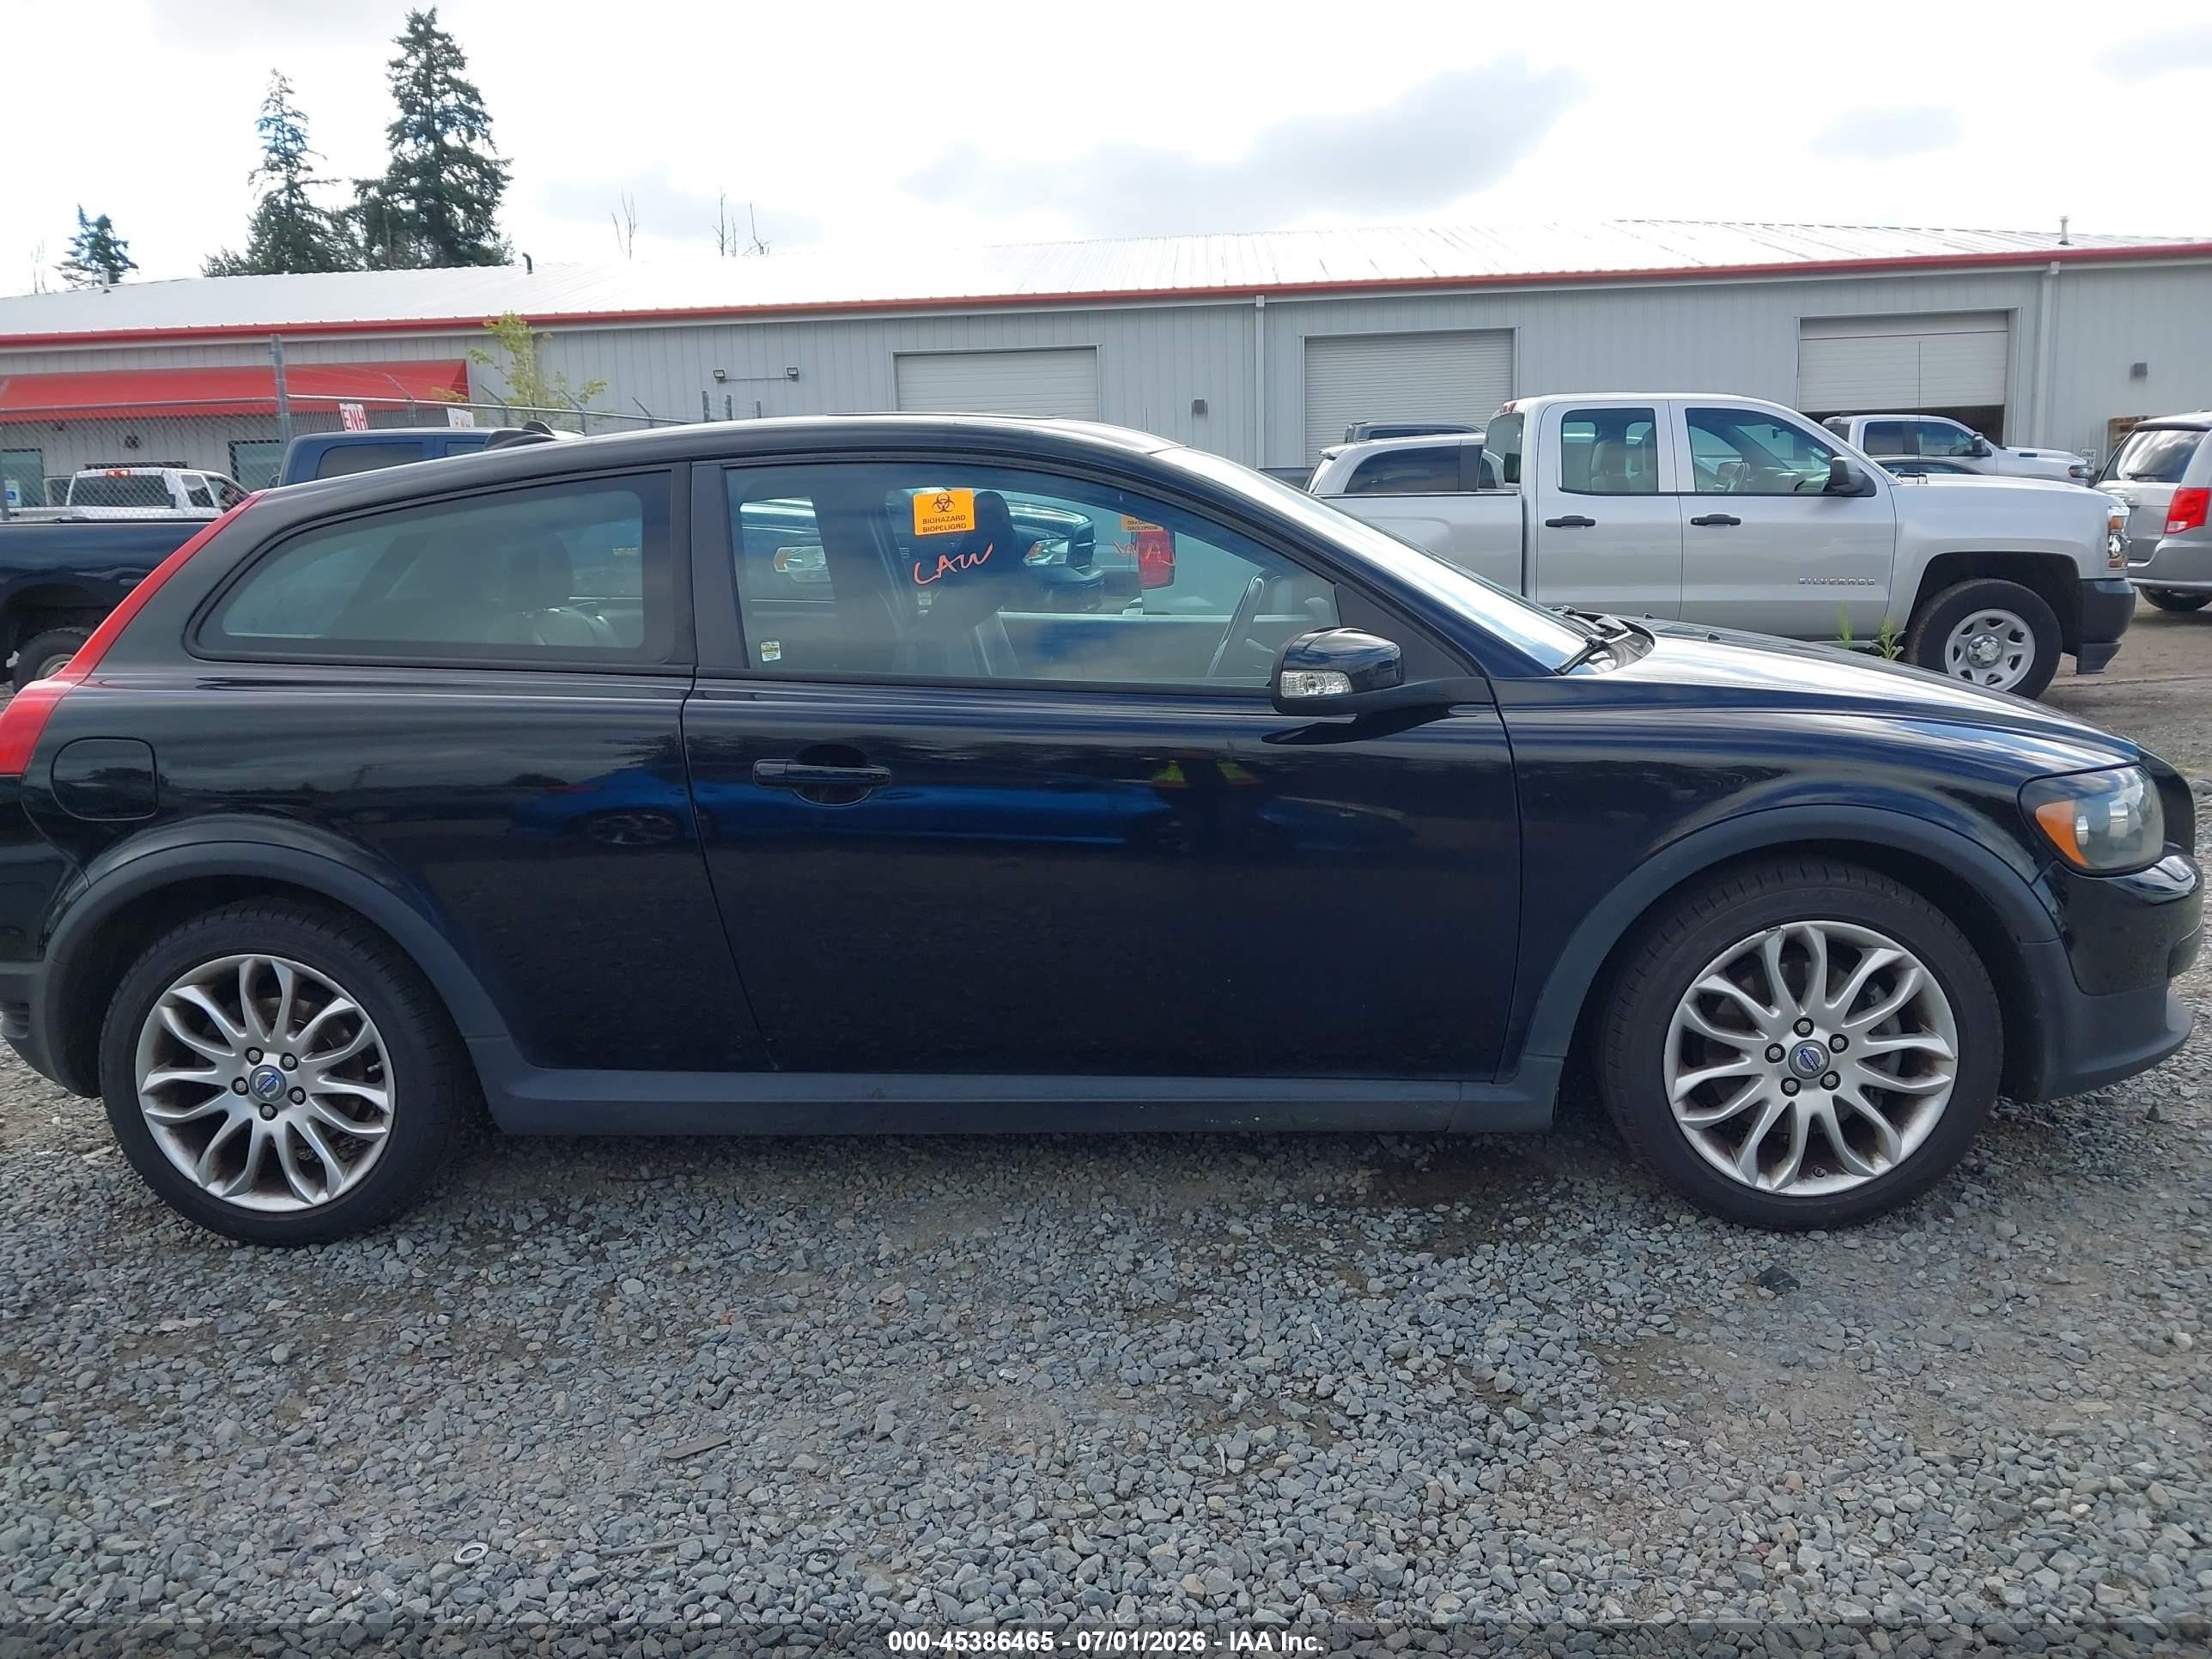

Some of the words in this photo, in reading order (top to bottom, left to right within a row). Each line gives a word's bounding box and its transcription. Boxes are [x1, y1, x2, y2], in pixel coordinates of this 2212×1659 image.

[922, 514, 966, 525] BIOHAZARD
[922, 522, 967, 532] BIOPELIGRO
[914, 542, 994, 585] LAW
[1798, 577, 1876, 586] SILVERADO
[1802, 1048, 1819, 1071] VOLVO
